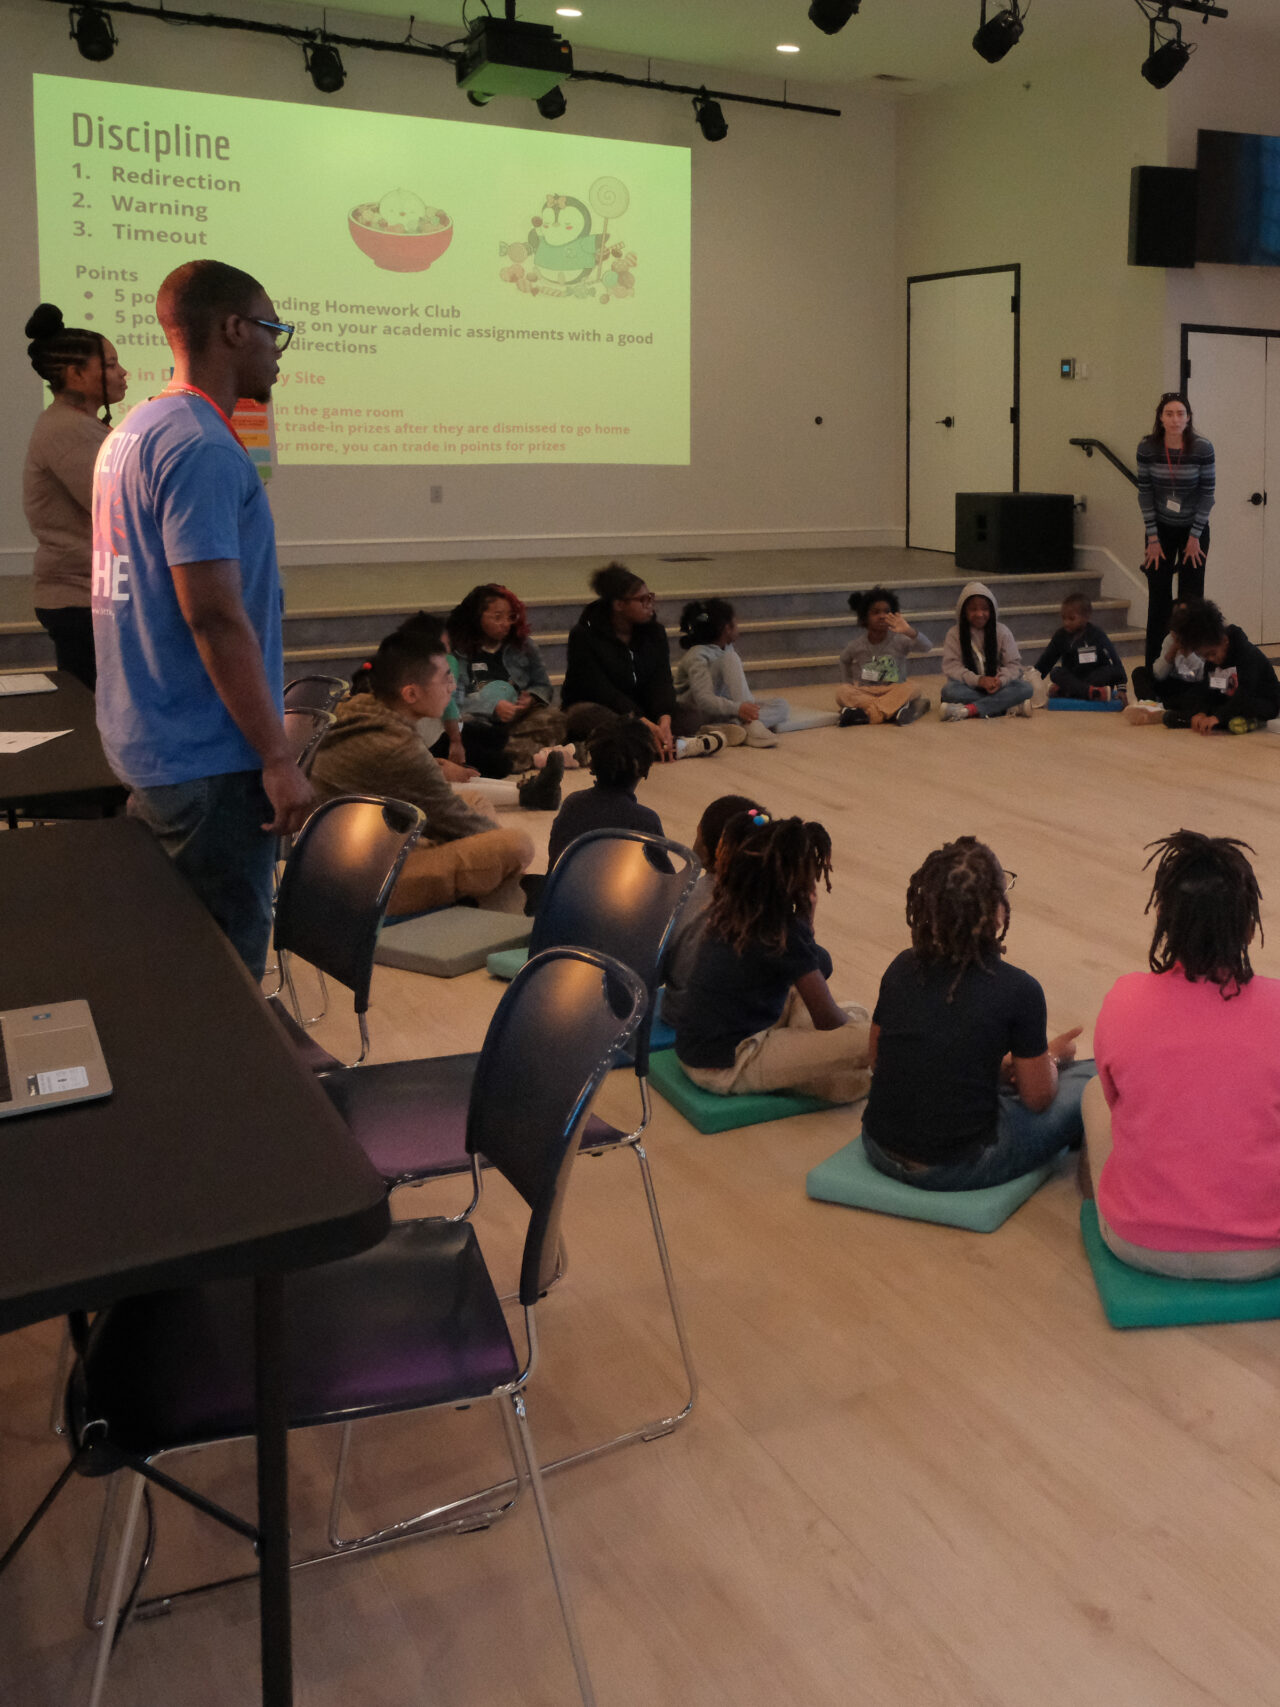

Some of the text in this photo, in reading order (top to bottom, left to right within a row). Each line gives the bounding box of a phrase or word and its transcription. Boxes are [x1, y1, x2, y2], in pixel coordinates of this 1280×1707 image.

[72, 112, 230, 162] Discipline
[72, 163, 241, 192] 1. Redirection
[72, 192, 208, 222] 2. Warning
[73, 221, 208, 245] 3. Timeout
[76, 265, 138, 282] Points
[114, 289, 461, 318] 5 po nding Homework Club
[115, 310, 126, 324] 5
[133, 313, 157, 328] po
[311, 321, 332, 332] on
[338, 322, 377, 336] your
[383, 323, 461, 338] academic
[466, 326, 564, 342] assignments
[568, 329, 601, 342] with
[606, 332, 614, 342] a
[618, 332, 653, 347] good
[116, 332, 377, 354] attitu directions
[138, 368, 154, 381] in
[295, 371, 326, 385] Site
[275, 405, 404, 419] in the game room
[286, 421, 343, 433] trade-in
[348, 422, 390, 436] prizes
[394, 422, 429, 434] after
[433, 423, 463, 437] they
[467, 424, 489, 434] are
[493, 422, 557, 434] dismissed
[560, 424, 573, 434] to
[577, 425, 591, 437] go
[595, 424, 631, 435] home
[296, 442, 338, 454] more,
[342, 442, 369, 455] you
[373, 442, 399, 452] can
[402, 441, 439, 452] trade
[444, 441, 457, 451] in
[461, 441, 502, 455] points
[506, 440, 525, 451] for
[528, 440, 566, 454] prizes
